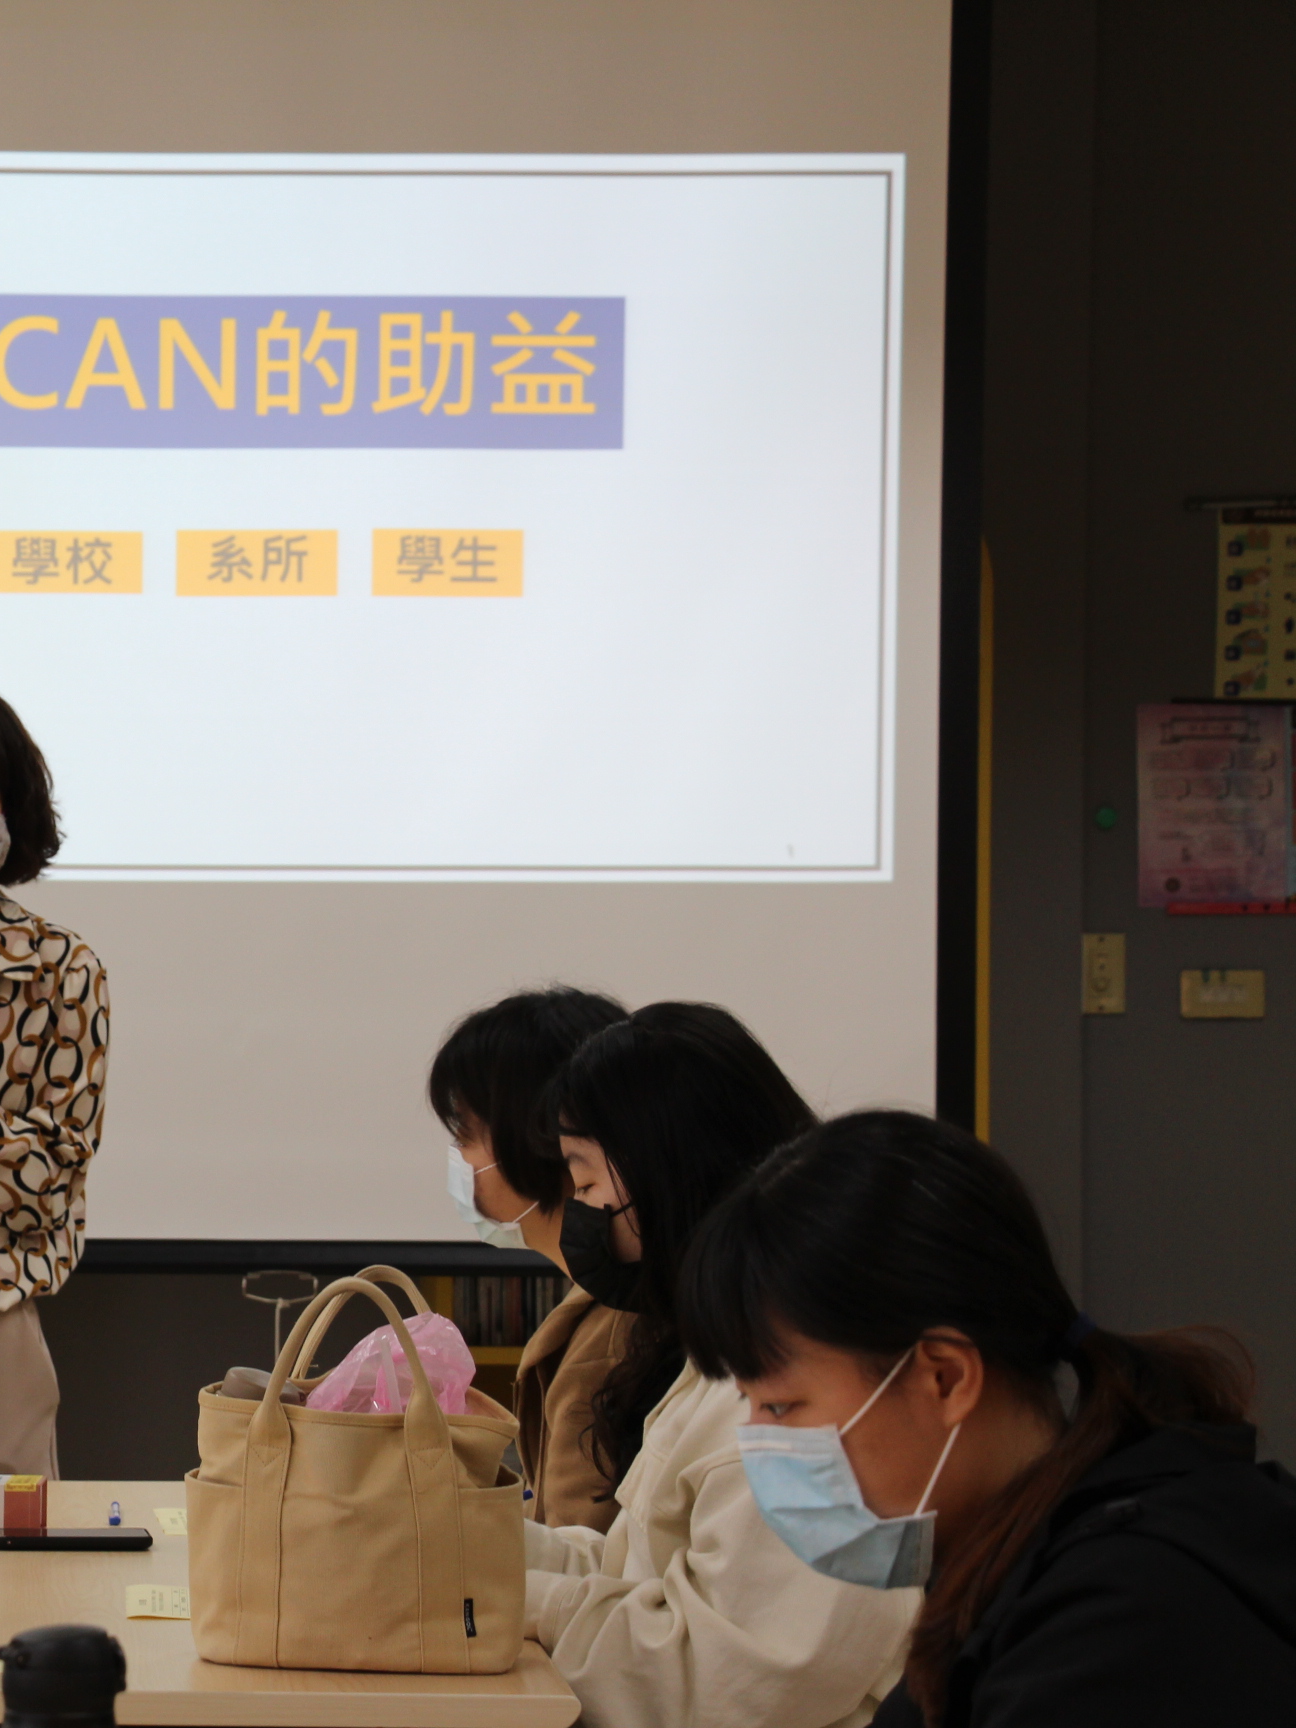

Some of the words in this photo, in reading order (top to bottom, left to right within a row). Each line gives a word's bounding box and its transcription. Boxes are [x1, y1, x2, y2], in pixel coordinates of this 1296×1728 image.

[11, 537, 114, 586] 學校
[207, 535, 310, 585] 系所
[396, 535, 499, 584] 學生
